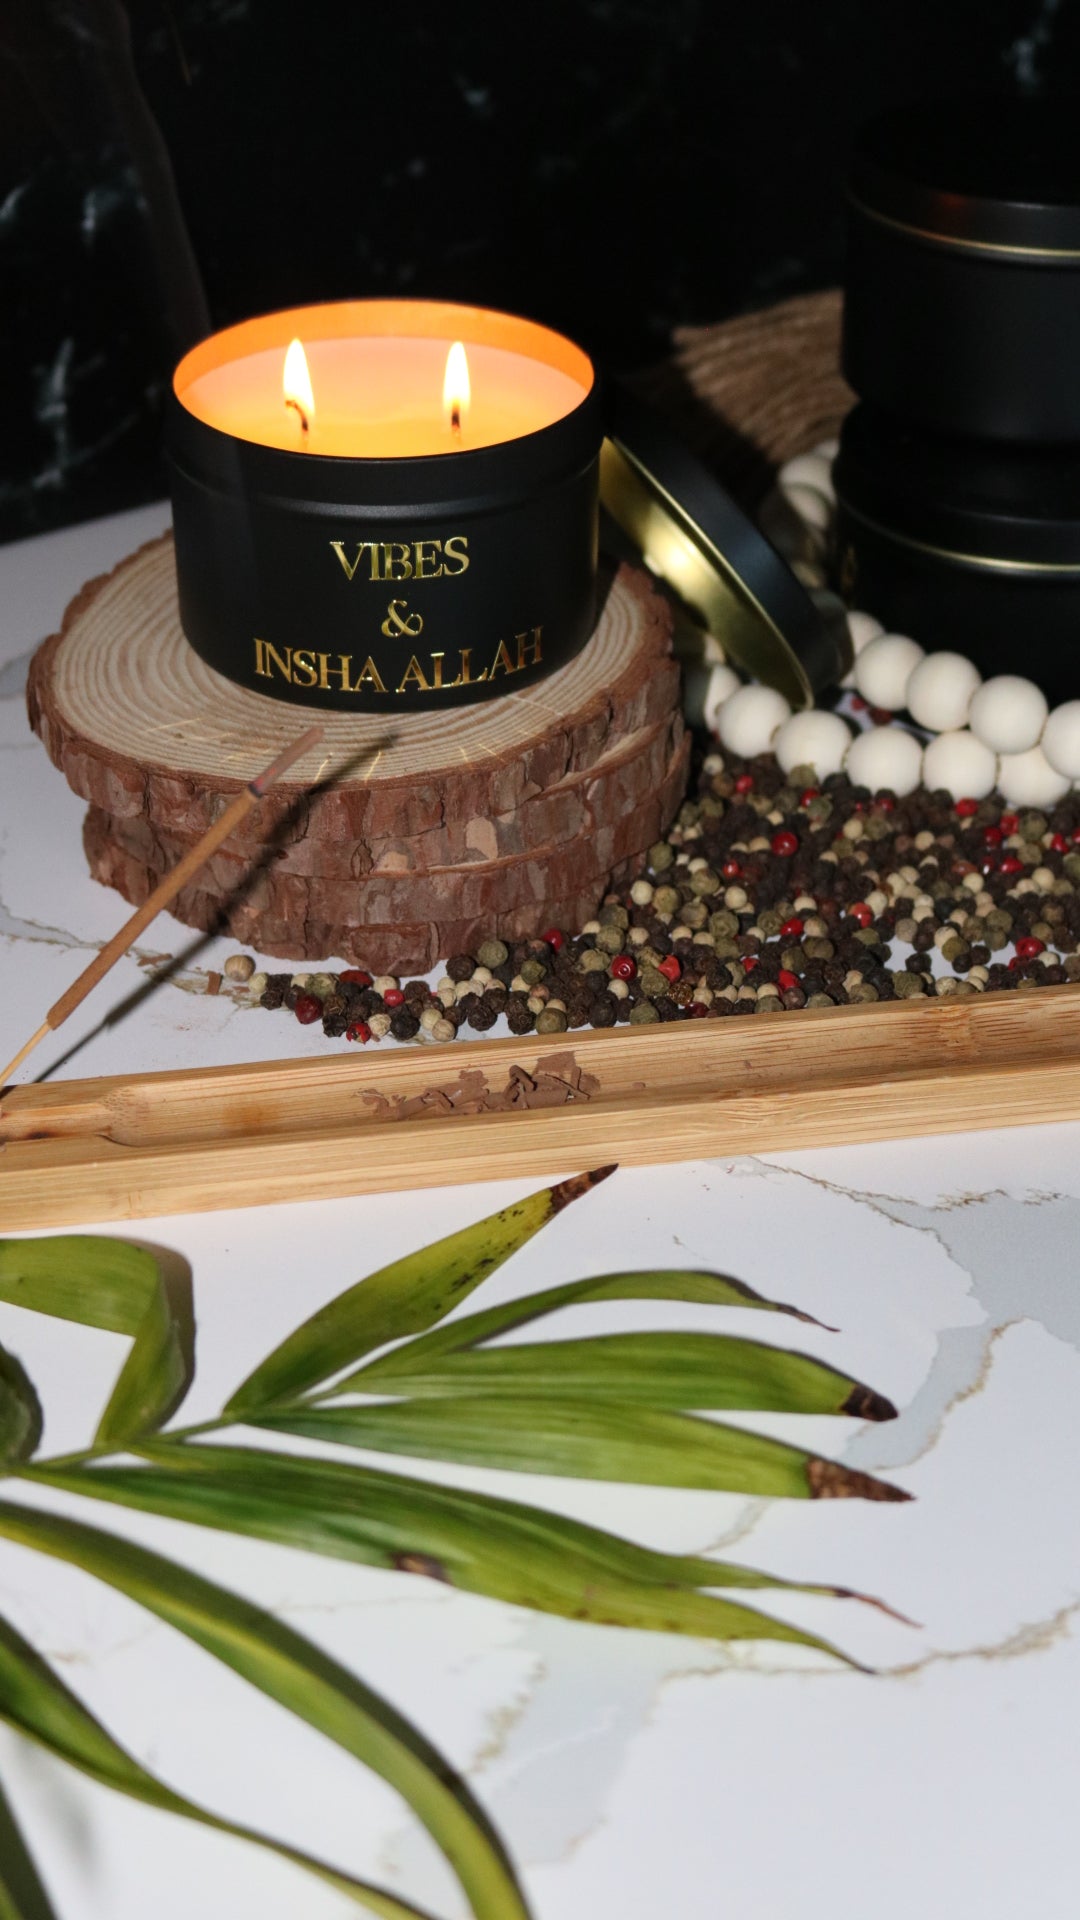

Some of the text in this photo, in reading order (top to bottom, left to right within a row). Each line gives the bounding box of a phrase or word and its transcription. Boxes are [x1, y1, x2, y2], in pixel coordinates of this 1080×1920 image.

[329, 536, 471, 581] VIBES
[381, 599, 424, 638] &
[253, 626, 544, 694] INSHA ALLAH
